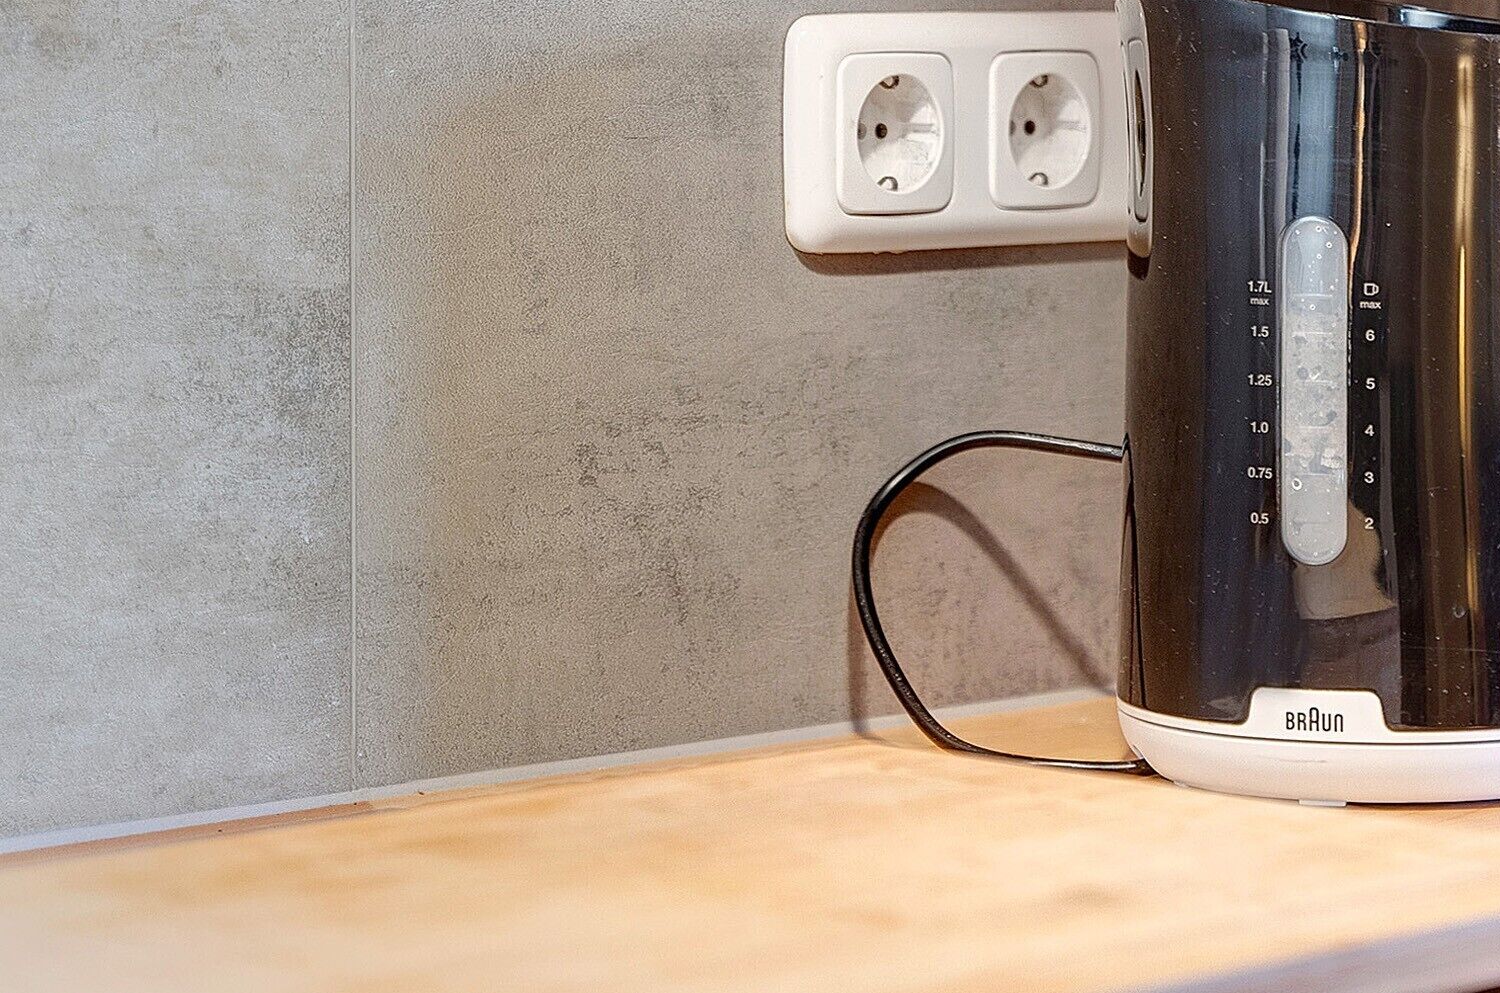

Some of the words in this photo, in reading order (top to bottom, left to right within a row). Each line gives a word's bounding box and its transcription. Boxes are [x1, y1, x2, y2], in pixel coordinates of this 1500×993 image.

[1248, 280, 1272, 293] 1.7L
[1250, 297, 1270, 306] max
[1359, 301, 1382, 309] max
[1250, 325, 1269, 338] 1.5
[1365, 329, 1376, 342] 6
[1247, 374, 1272, 387] 1.25
[1365, 377, 1376, 390] 5
[1250, 421, 1269, 434] 1.0
[1364, 424, 1375, 437] 4
[1247, 466, 1273, 480] 0.75
[1364, 471, 1375, 484] 3
[1250, 512, 1270, 525] 0.5
[1364, 517, 1375, 530] 2
[1285, 706, 1344, 733] BRAUN
